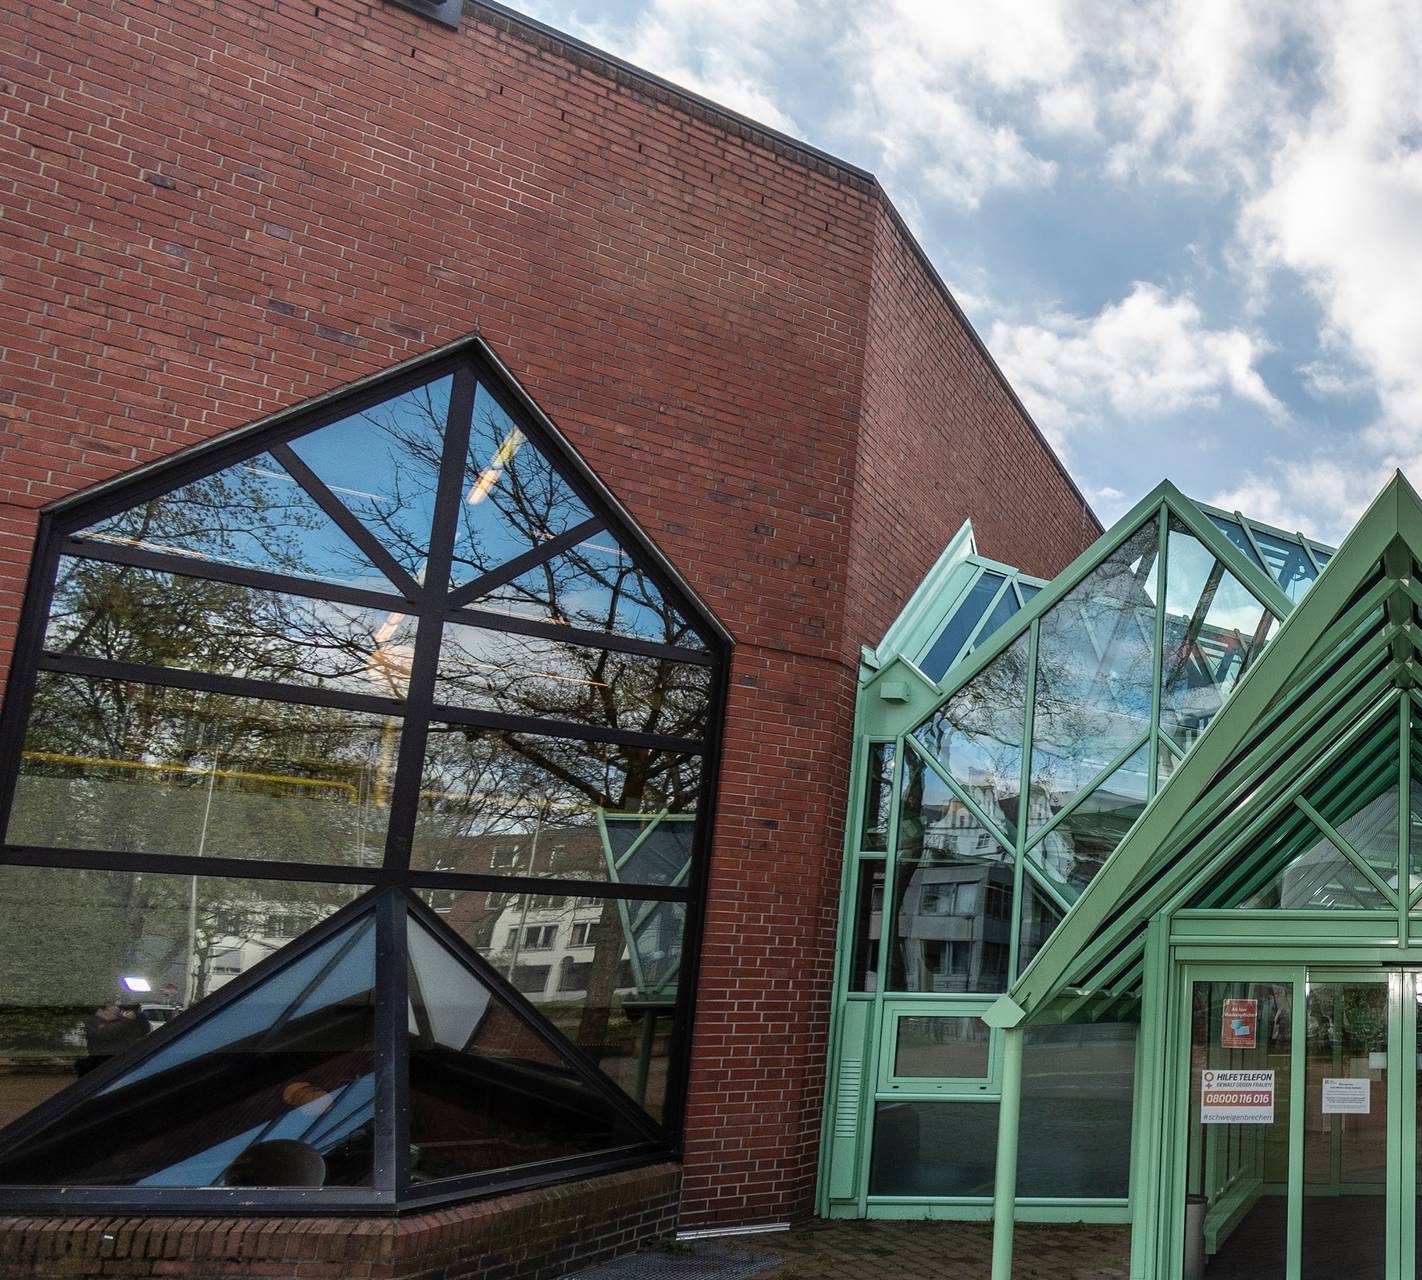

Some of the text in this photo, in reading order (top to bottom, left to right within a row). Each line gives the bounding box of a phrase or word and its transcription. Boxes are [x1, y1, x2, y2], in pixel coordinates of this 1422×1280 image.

[1216, 1073, 1273, 1081] HILFE TELEFON
[1206, 1094, 1270, 1104] 08000 116 016
